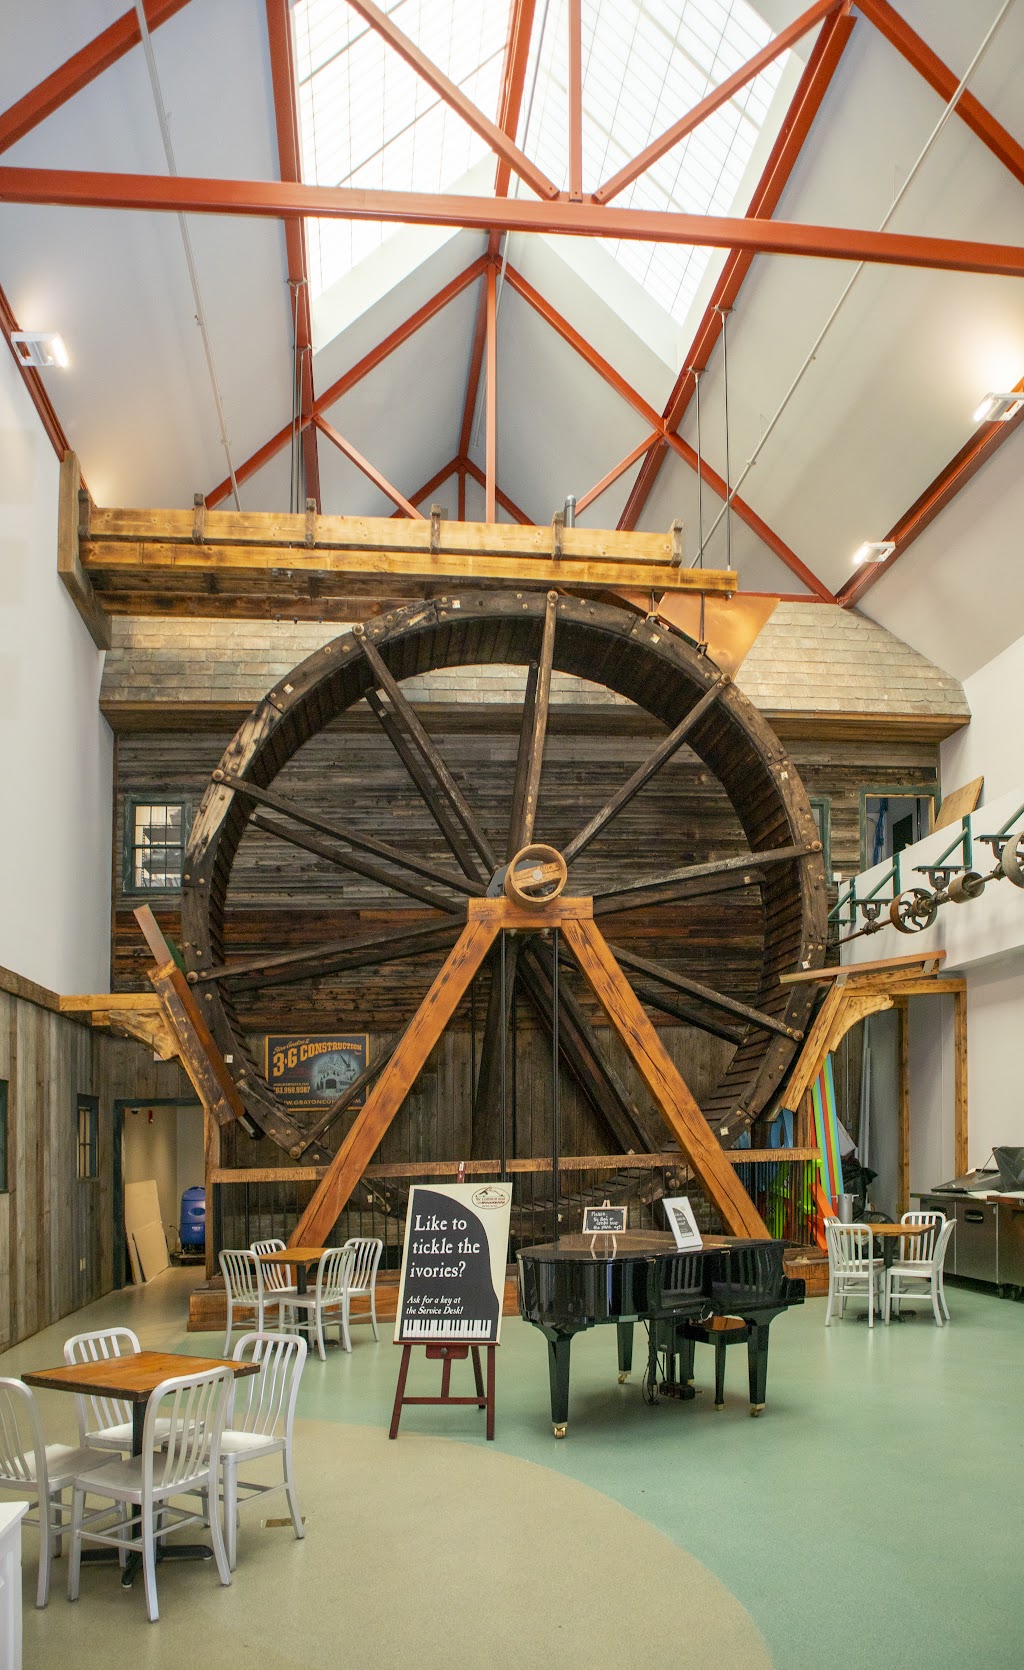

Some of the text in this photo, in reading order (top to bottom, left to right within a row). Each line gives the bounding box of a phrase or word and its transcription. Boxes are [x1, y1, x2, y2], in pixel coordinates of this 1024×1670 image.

[300, 1041, 362, 1062] CONSTRUCTION
[414, 1214, 467, 1231] Like to
[412, 1237, 480, 1254] tickle the
[409, 1260, 466, 1278] ivories?
[406, 1295, 421, 1304] Ask
[421, 1294, 434, 1306] for
[440, 1295, 453, 1306] key
[453, 1296, 461, 1304] at
[406, 1305, 464, 1315] the Service Desk!
